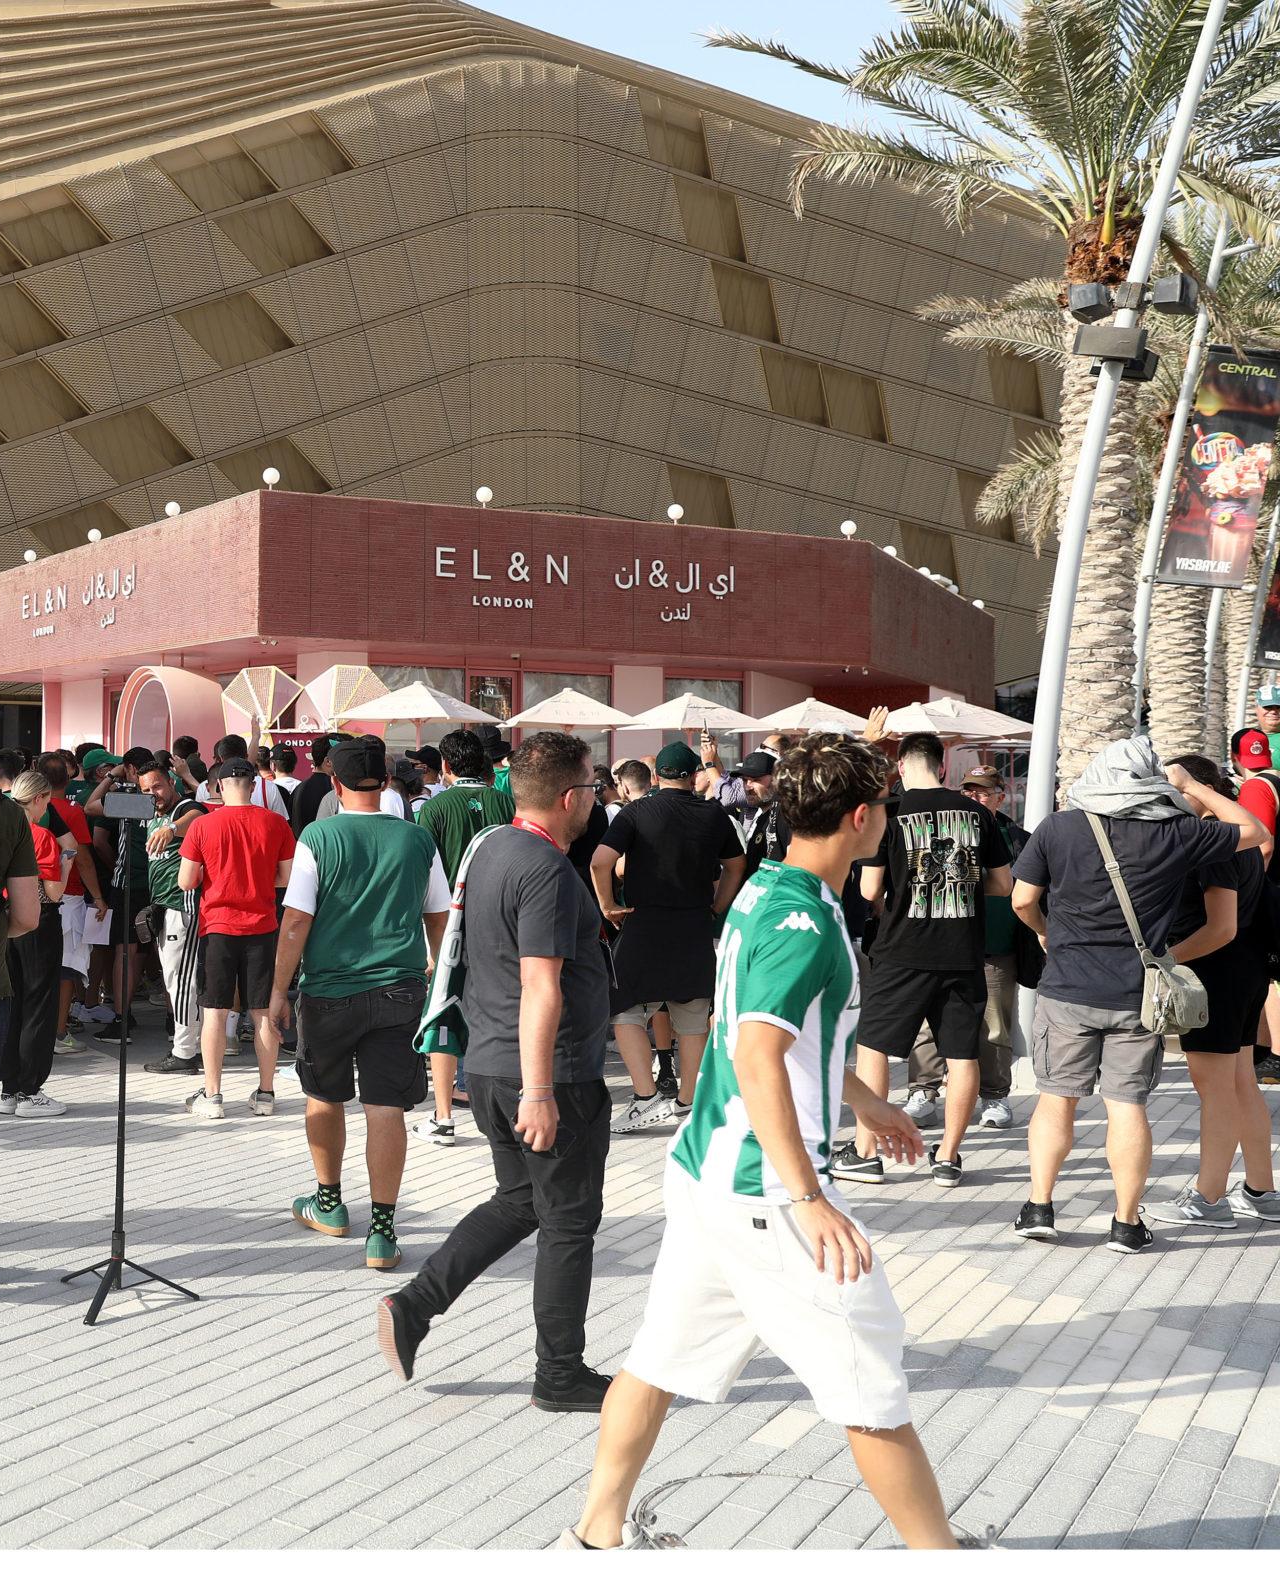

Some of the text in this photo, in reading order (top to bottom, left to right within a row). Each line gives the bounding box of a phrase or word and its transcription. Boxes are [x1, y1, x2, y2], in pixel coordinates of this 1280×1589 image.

[1218, 362, 1277, 379] CENTRAL
[1175, 556, 1232, 574] YASBAY.AE
[472, 595, 534, 609] LONDON
[660, 603, 691, 622] لندن
[897, 810, 981, 850] THE KING
[907, 883, 928, 919] IS
